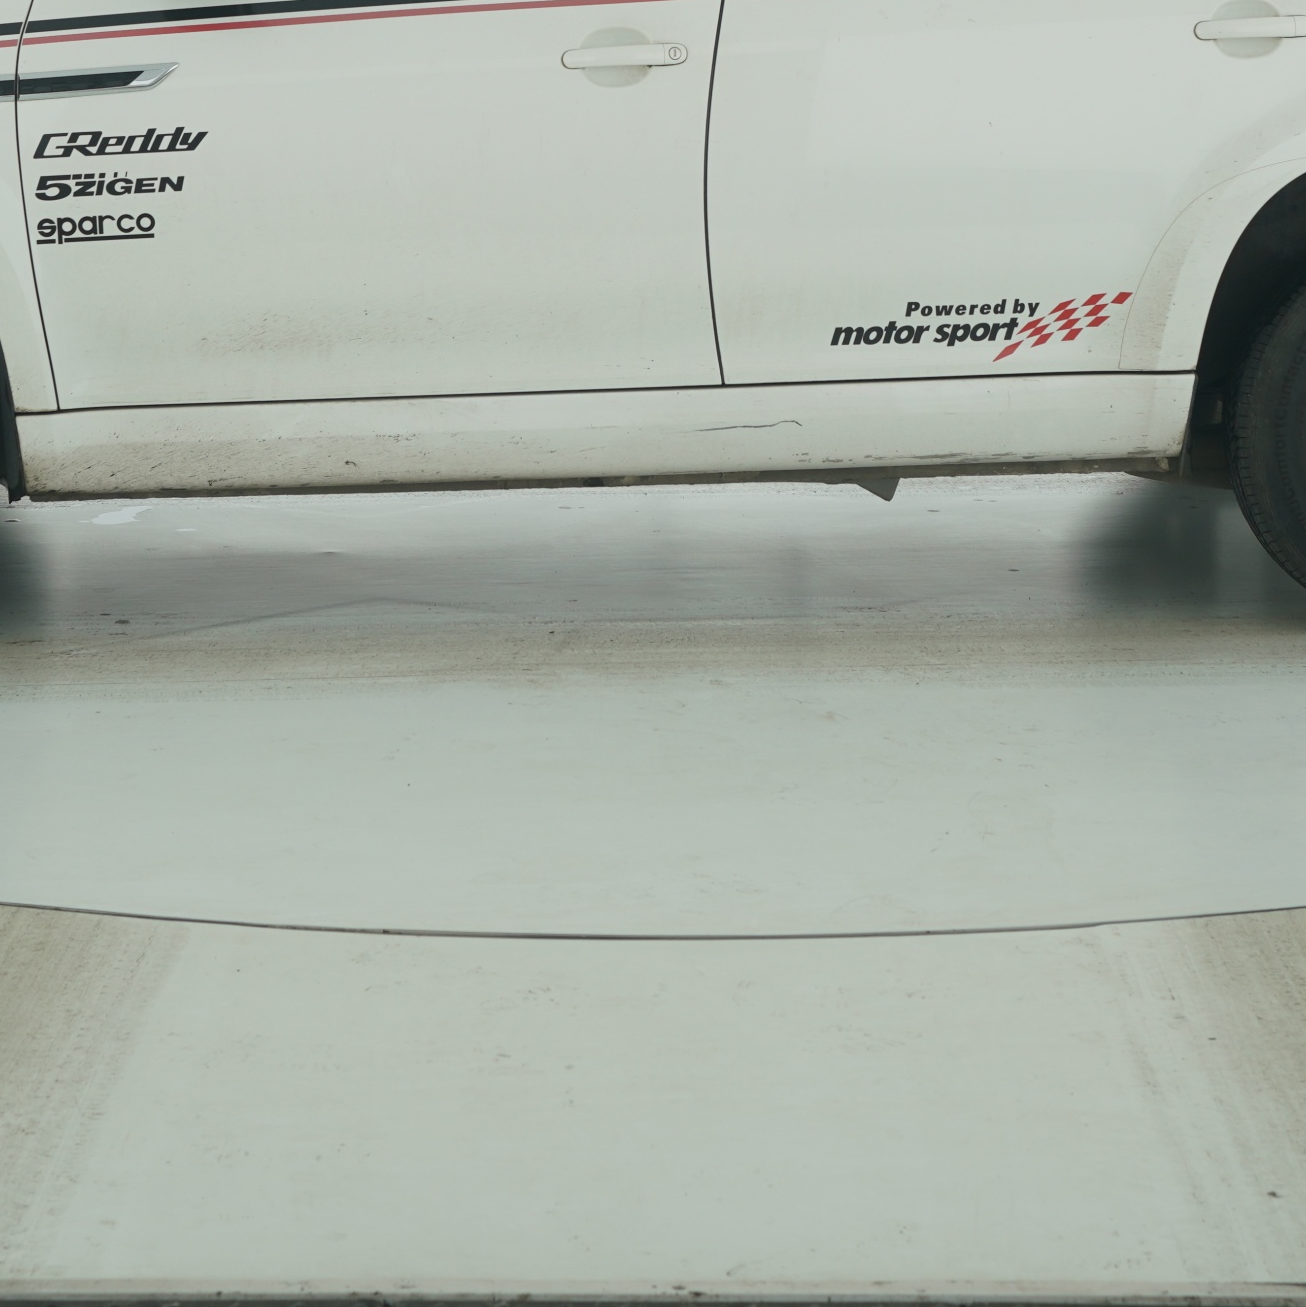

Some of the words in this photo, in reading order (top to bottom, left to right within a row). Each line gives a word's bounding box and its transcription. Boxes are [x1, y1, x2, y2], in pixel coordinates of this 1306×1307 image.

[36, 212, 156, 245] sparco
[905, 298, 1007, 317] Powered
[1012, 298, 1040, 317] by
[830, 321, 930, 346] motor
[933, 317, 1019, 347] sport
